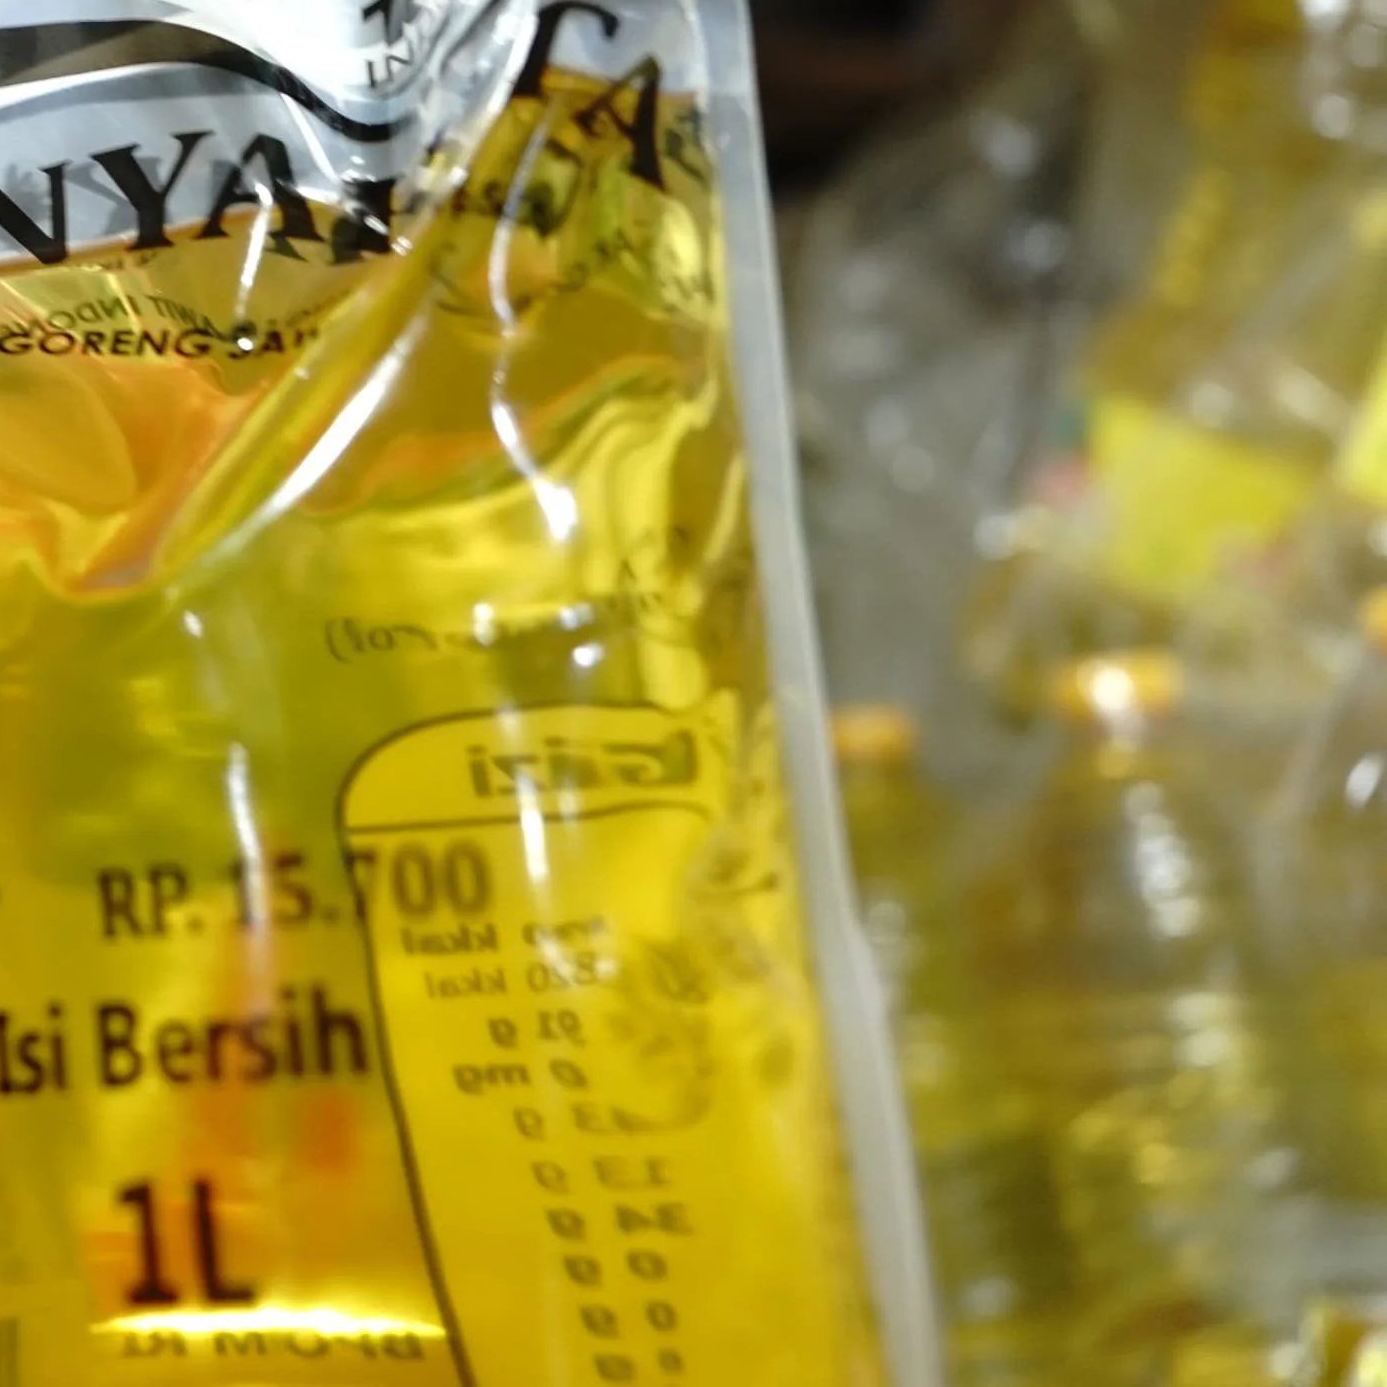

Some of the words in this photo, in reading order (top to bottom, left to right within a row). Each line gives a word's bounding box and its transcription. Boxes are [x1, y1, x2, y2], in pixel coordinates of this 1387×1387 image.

[97, 866, 205, 938] RP.
[94, 987, 371, 1088] Bersih
[117, 1180, 256, 1307] 1L
